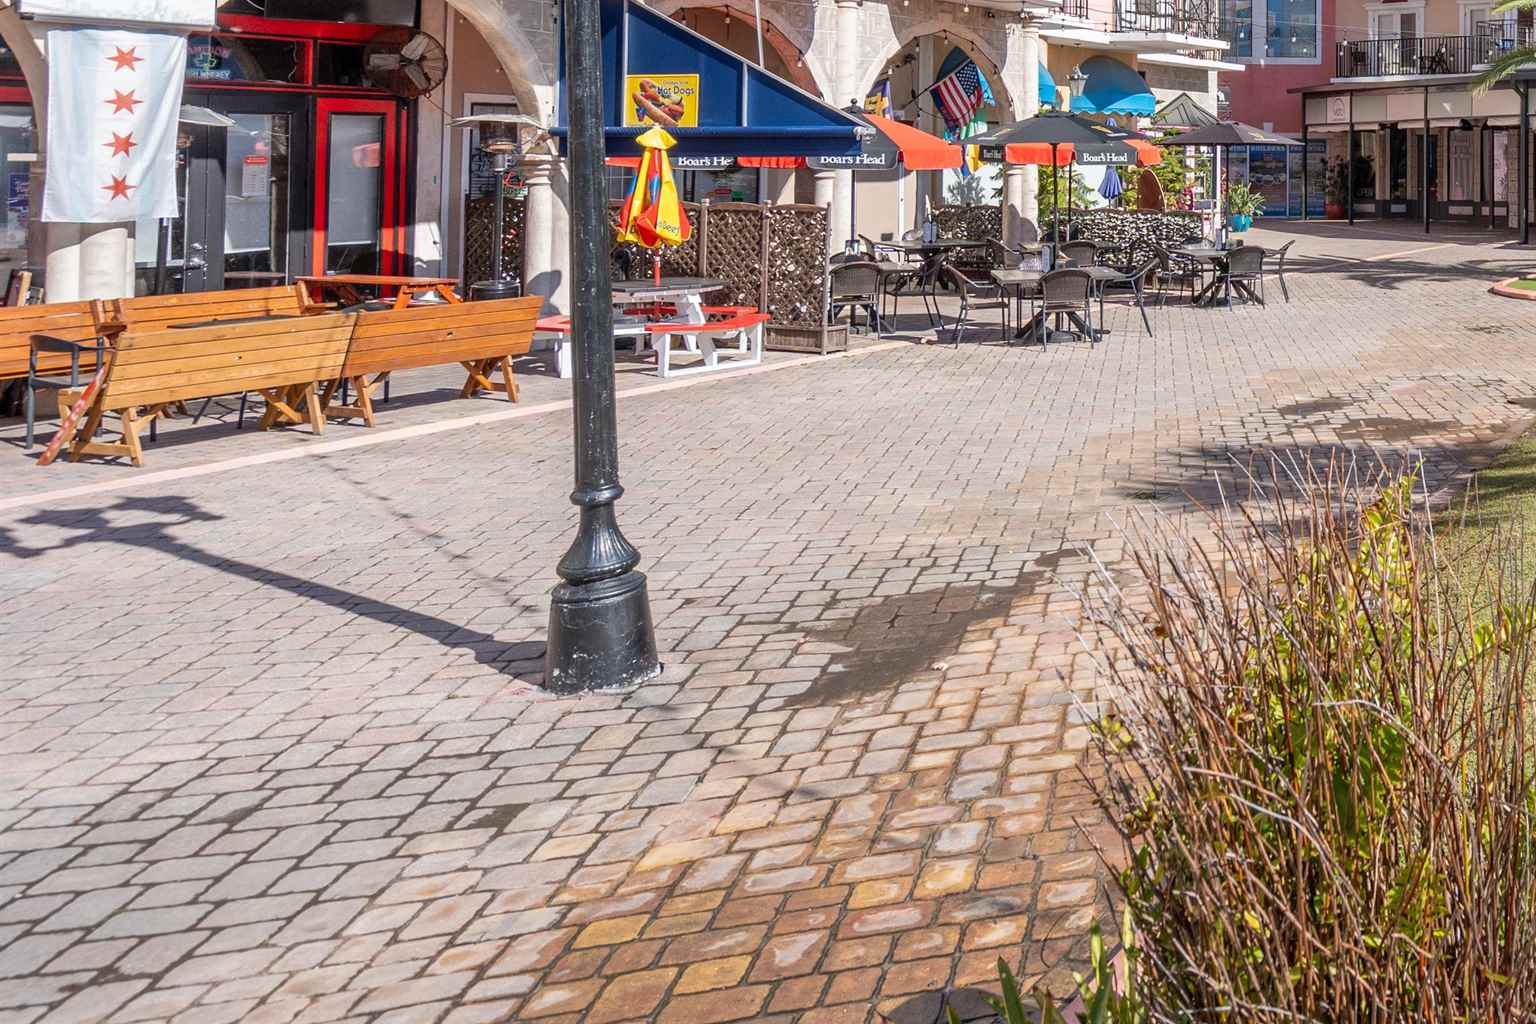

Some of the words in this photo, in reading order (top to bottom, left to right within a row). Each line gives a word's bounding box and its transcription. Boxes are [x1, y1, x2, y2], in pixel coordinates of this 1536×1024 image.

[657, 85, 672, 96] Hot
[674, 85, 695, 96] Dogs
[713, 156, 734, 166] He
[819, 155, 854, 165] Boars
[855, 153, 885, 165] Head
[1083, 152, 1106, 162] Boar's
[1107, 152, 1128, 162] Head
